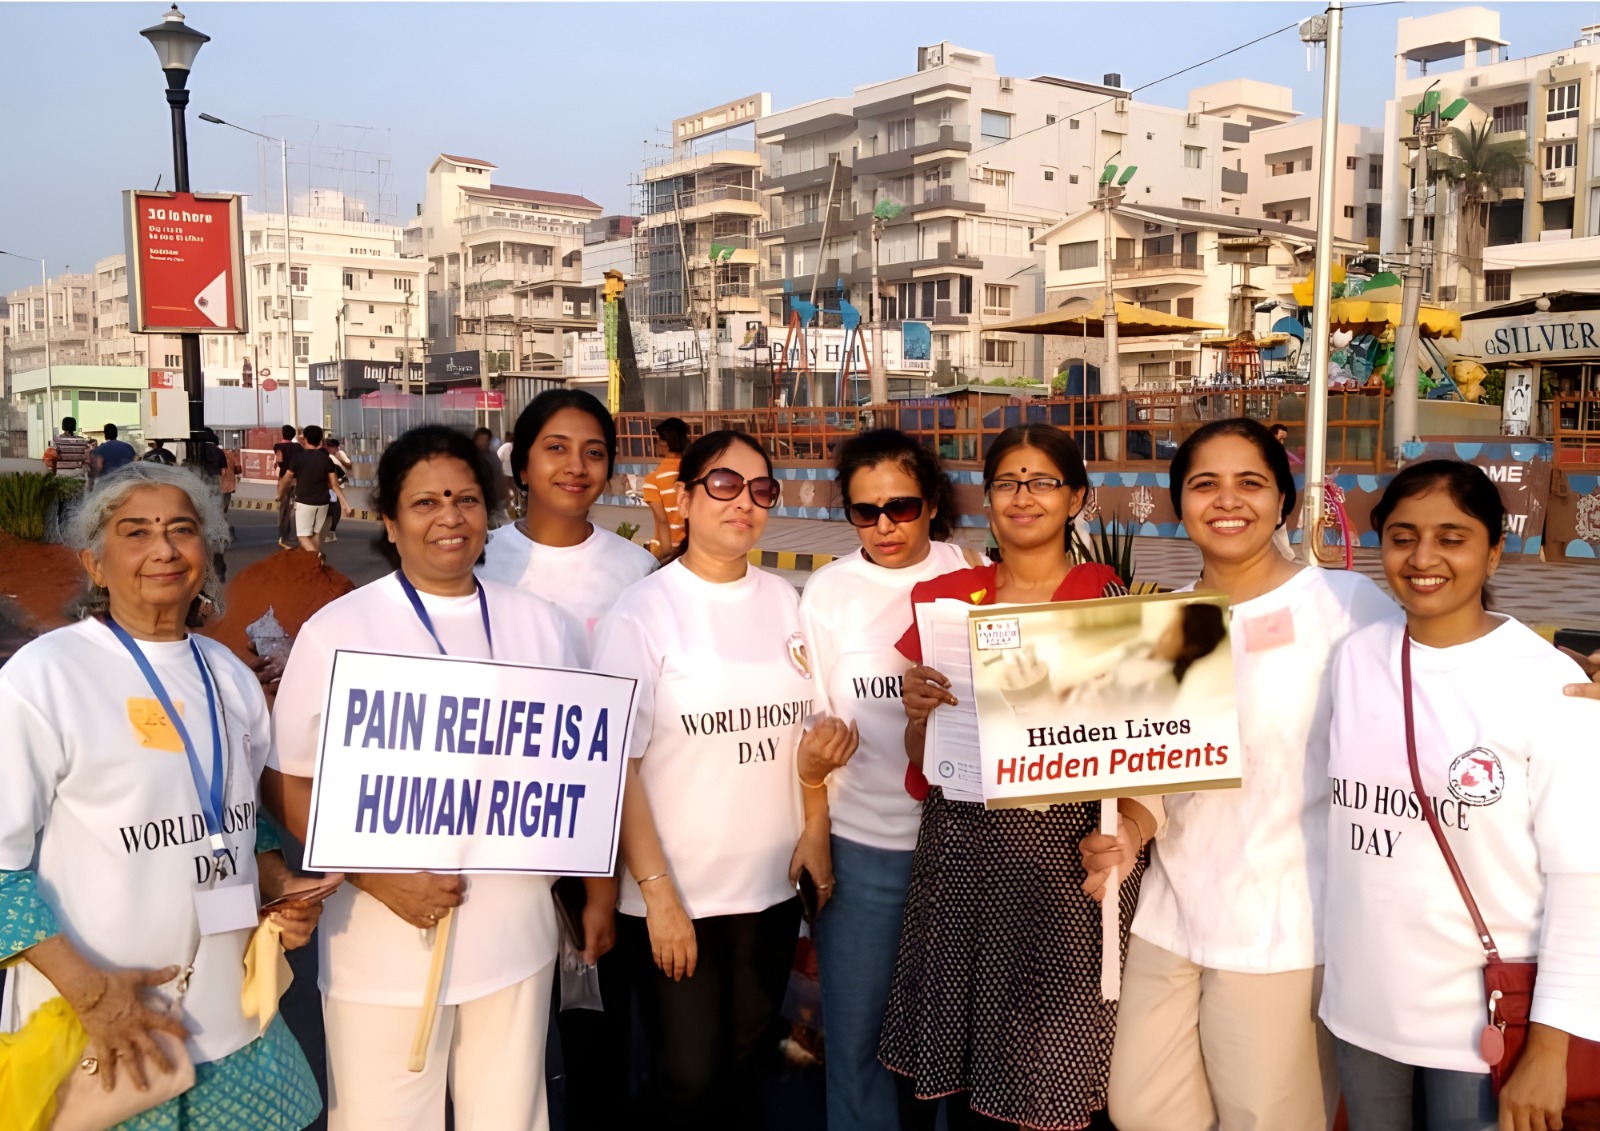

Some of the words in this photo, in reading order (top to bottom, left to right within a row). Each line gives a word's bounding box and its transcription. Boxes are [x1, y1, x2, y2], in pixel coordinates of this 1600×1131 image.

[343, 688, 427, 751] PAIN
[434, 695, 546, 757] RELIFE
[551, 703, 583, 760] IS
[587, 707, 609, 762] A
[681, 707, 751, 736] WORLD
[1027, 726, 1117, 748] Hidden
[1125, 717, 1192, 739] Lives
[738, 737, 780, 764] DAY
[996, 752, 1100, 785] Hidden
[1108, 742, 1229, 775] Patients
[354, 774, 482, 836] HUMAN
[485, 780, 586, 838] RIGHT
[119, 812, 206, 855] WORLD
[1351, 822, 1403, 858] DAY
[194, 846, 239, 884] DY
